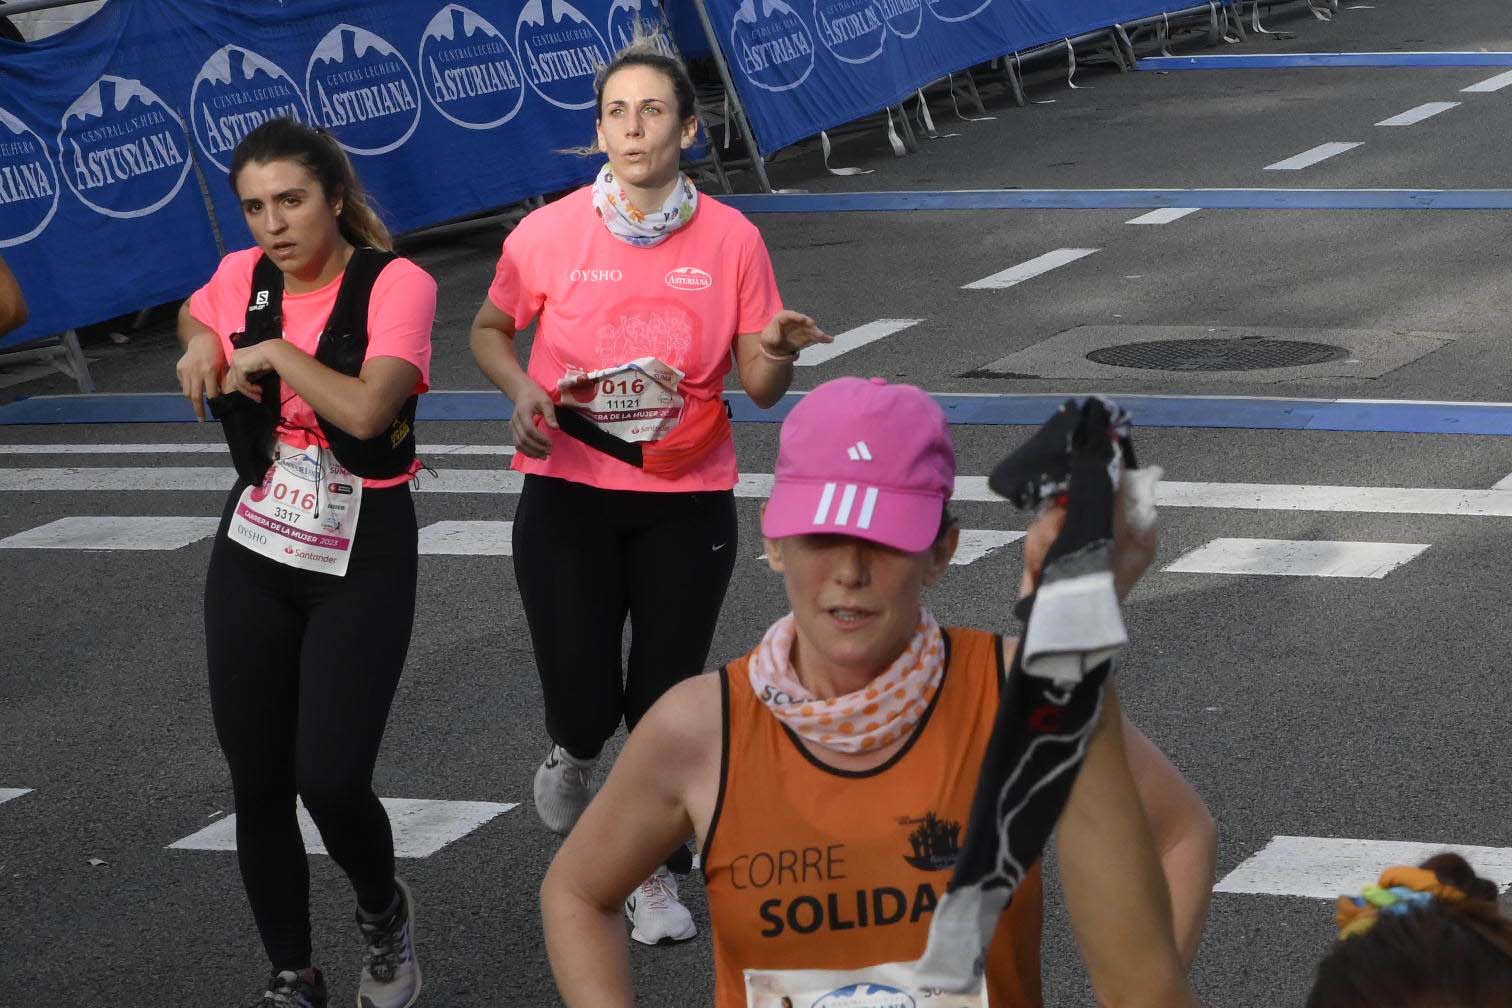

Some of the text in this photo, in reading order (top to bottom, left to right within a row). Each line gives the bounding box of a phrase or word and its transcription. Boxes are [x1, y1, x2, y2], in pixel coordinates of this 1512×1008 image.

[429, 56, 520, 103] ASTURIANA
[317, 79, 416, 129] ASTURIANA
[69, 130, 184, 191] ASTURIANA
[569, 269, 623, 282] OYSHO
[602, 378, 645, 395] 016
[606, 399, 640, 409] 11121
[632, 410, 658, 418] MUJER
[273, 482, 316, 511] 016
[244, 510, 271, 527] CARRERA
[270, 522, 282, 531] DE
[281, 525, 290, 535] LA
[291, 528, 318, 543] MUJER
[274, 506, 301, 524] 3317
[237, 524, 268, 545] OYSHO
[295, 548, 338, 565] Santander
[730, 843, 848, 890] CORRE
[759, 882, 951, 938] SOLIDA
